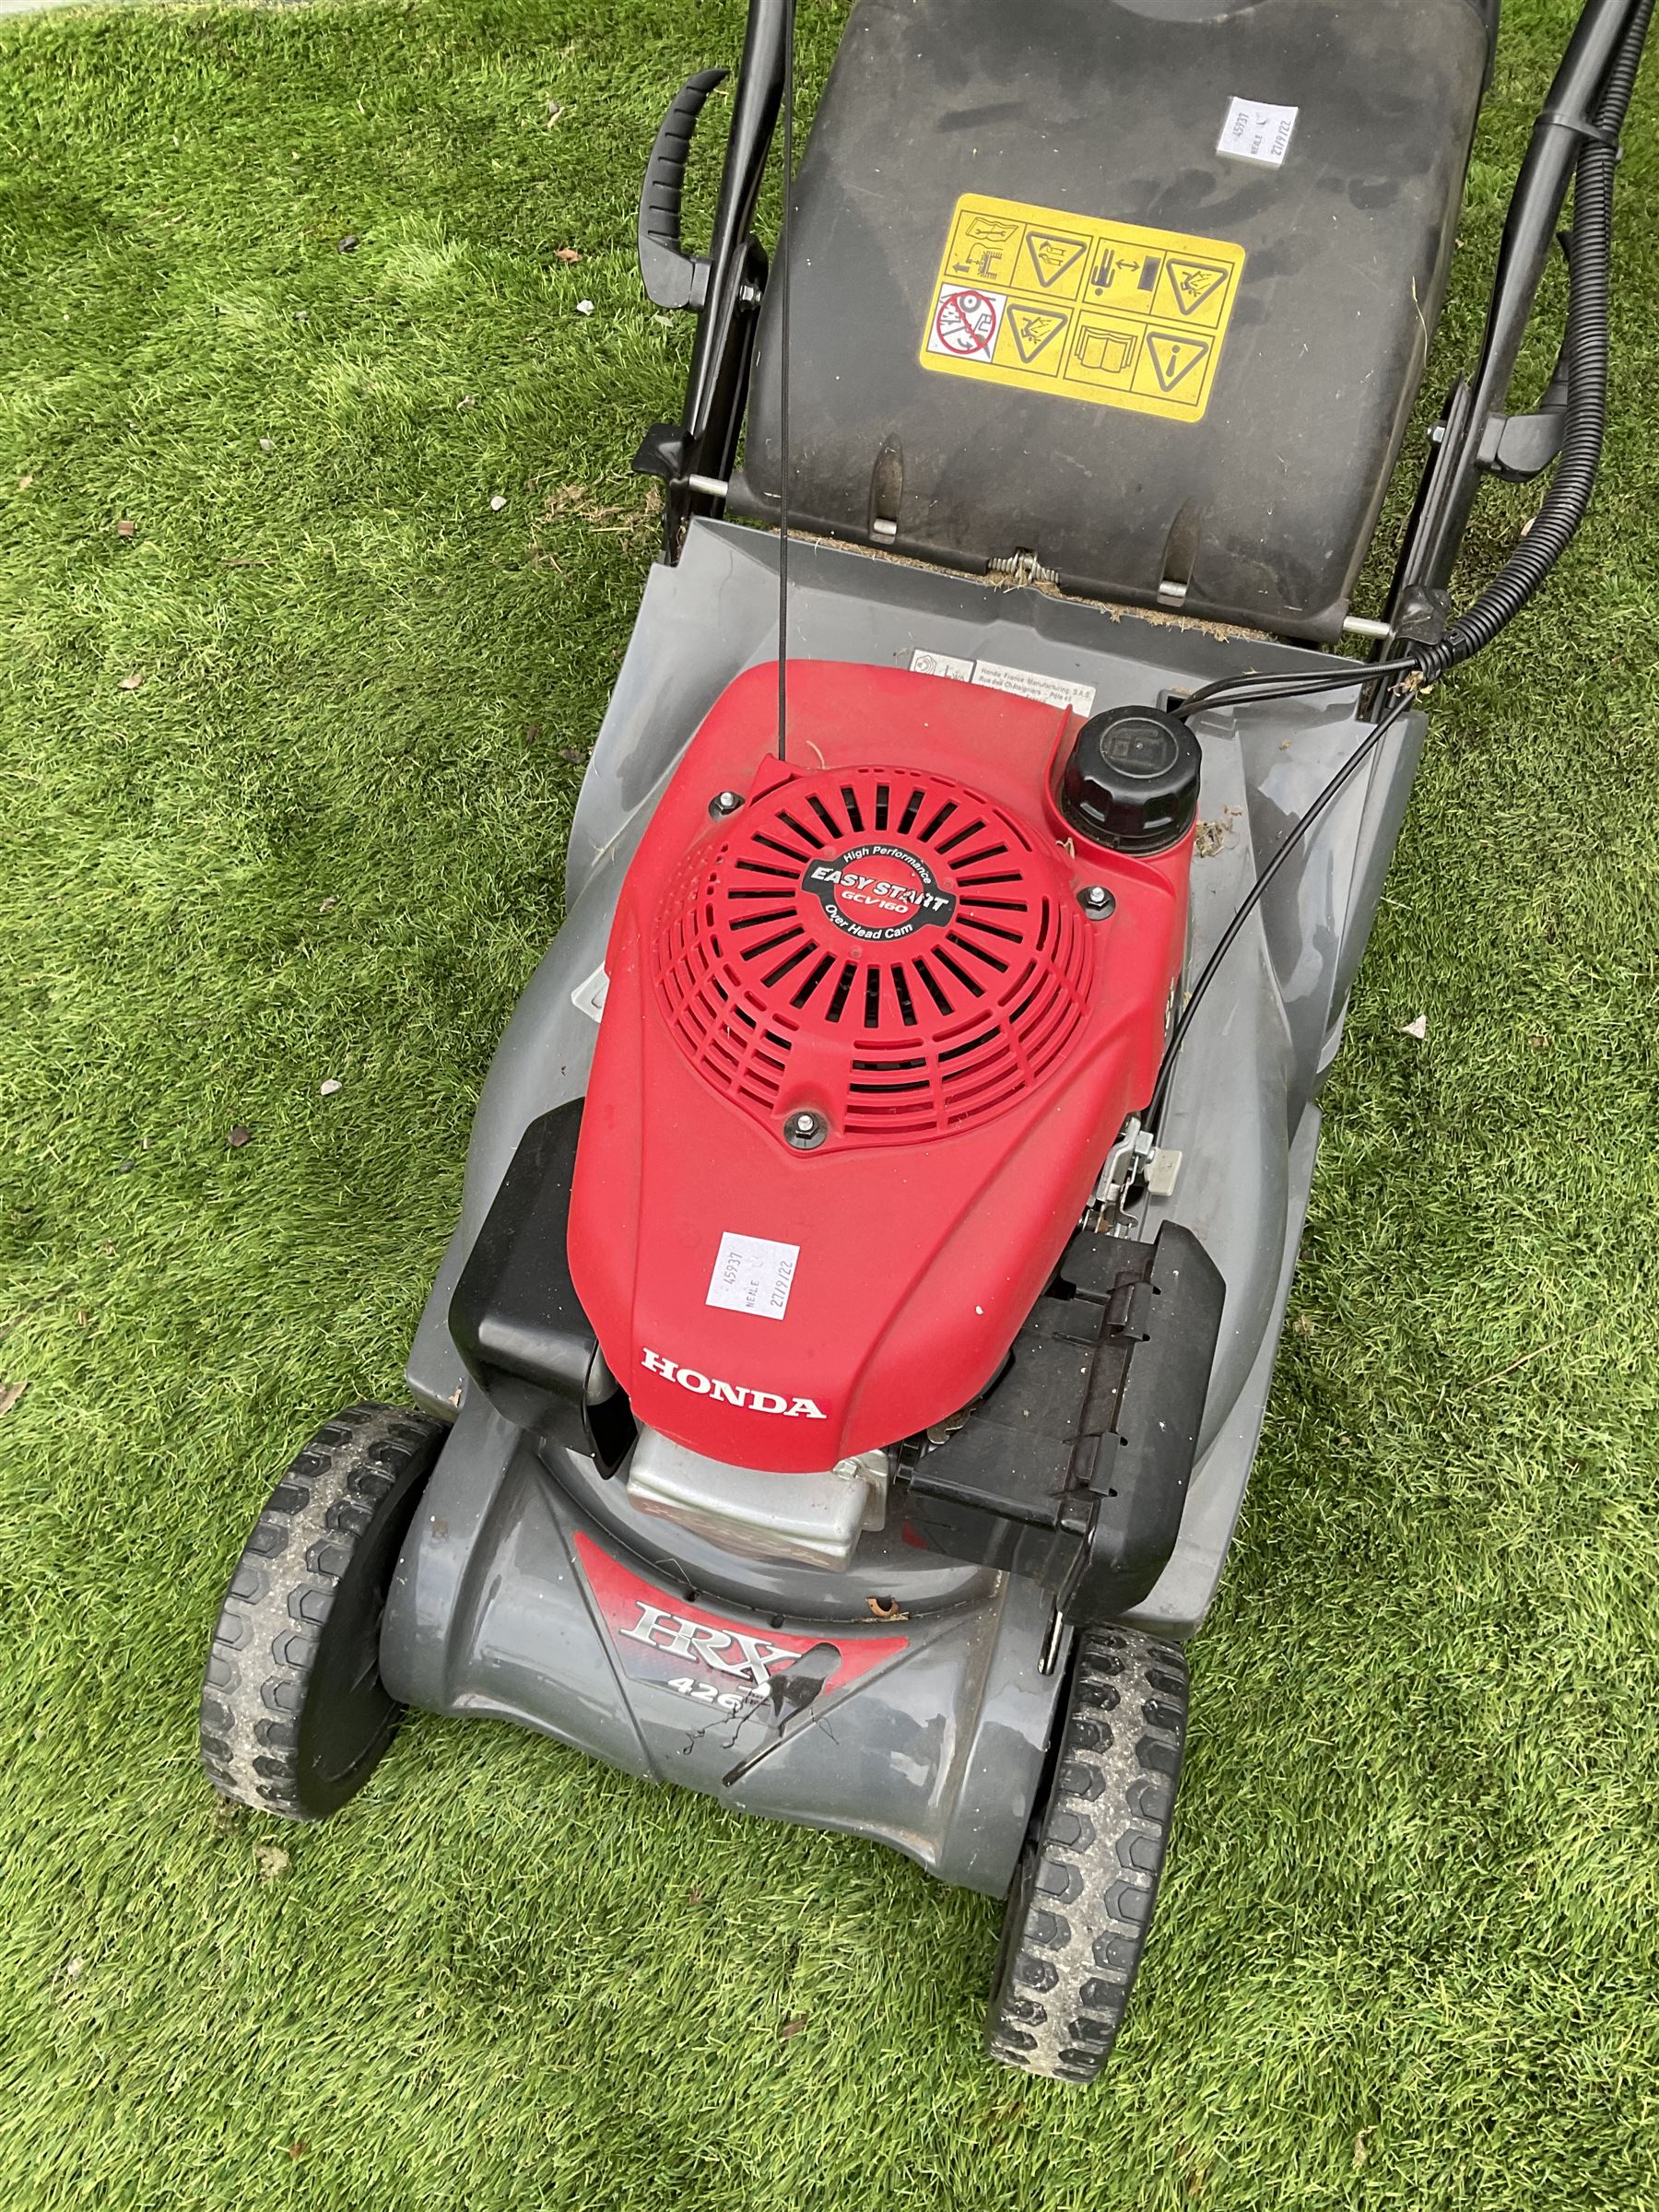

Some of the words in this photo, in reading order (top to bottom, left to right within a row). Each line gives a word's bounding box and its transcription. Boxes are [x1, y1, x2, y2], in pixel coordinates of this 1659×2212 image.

[1231, 112, 1250, 137] 45937
[1270, 120, 1291, 157] 27/9/22
[982, 666, 1002, 677] Honda
[1003, 672, 1025, 683] France
[1027, 677, 1070, 695] Manufacturing
[842, 846, 869, 864] High
[872, 845, 932, 885] Performance
[811, 866, 875, 890] EASY
[873, 881, 950, 912] START
[841, 890, 910, 914] GCV160
[825, 903, 848, 928] Over
[847, 923, 882, 940] Head
[884, 923, 913, 939] Cam
[723, 1252, 743, 1285] 45937
[770, 1260, 793, 1308] 27/9/22
[641, 1347, 828, 1419] HONDA
[618, 1600, 802, 1694] HRX
